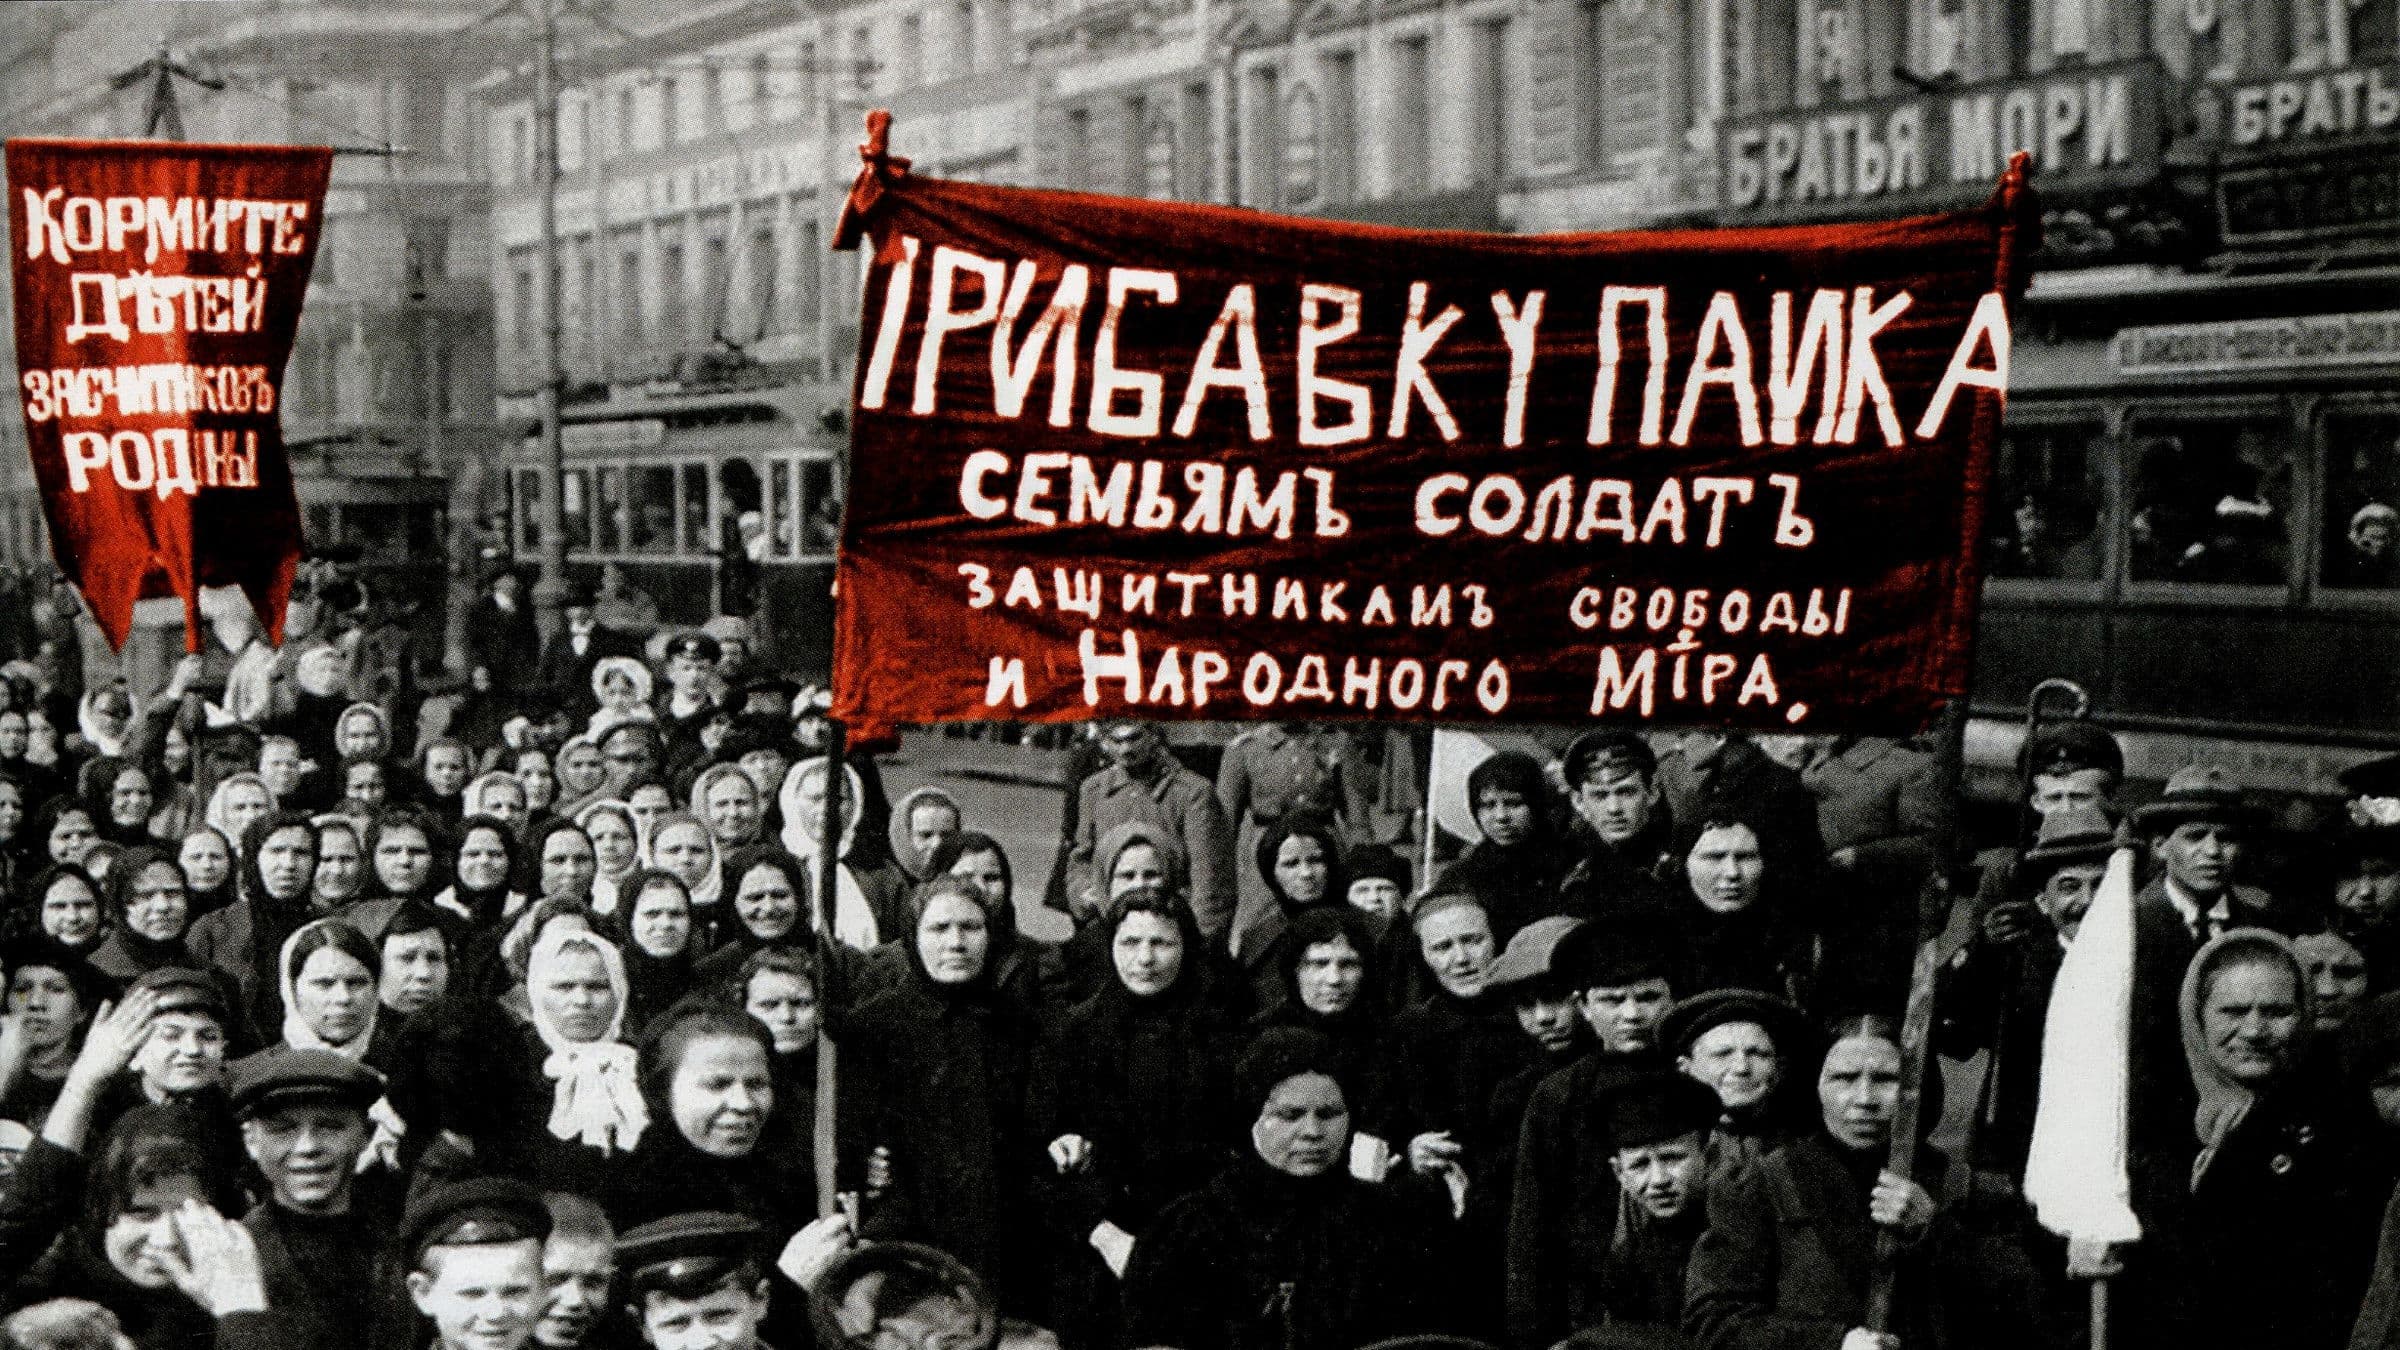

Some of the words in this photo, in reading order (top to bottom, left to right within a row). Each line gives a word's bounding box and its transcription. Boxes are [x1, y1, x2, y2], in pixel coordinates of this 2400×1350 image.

[1732, 104, 1924, 206] БРАТЬЯ
[1951, 74, 2129, 181] МОРИ
[23, 186, 307, 265] КОРМИТЕ
[958, 449, 1350, 540] СЕМЬЯМЪ
[1414, 473, 1815, 549] СОЛДАТЪ
[957, 562, 1495, 627] ЗАЩИТНИКАМЪ
[1569, 586, 1852, 636] СВОБОДЫ
[1077, 628, 1511, 714] НАРОДНОГО
